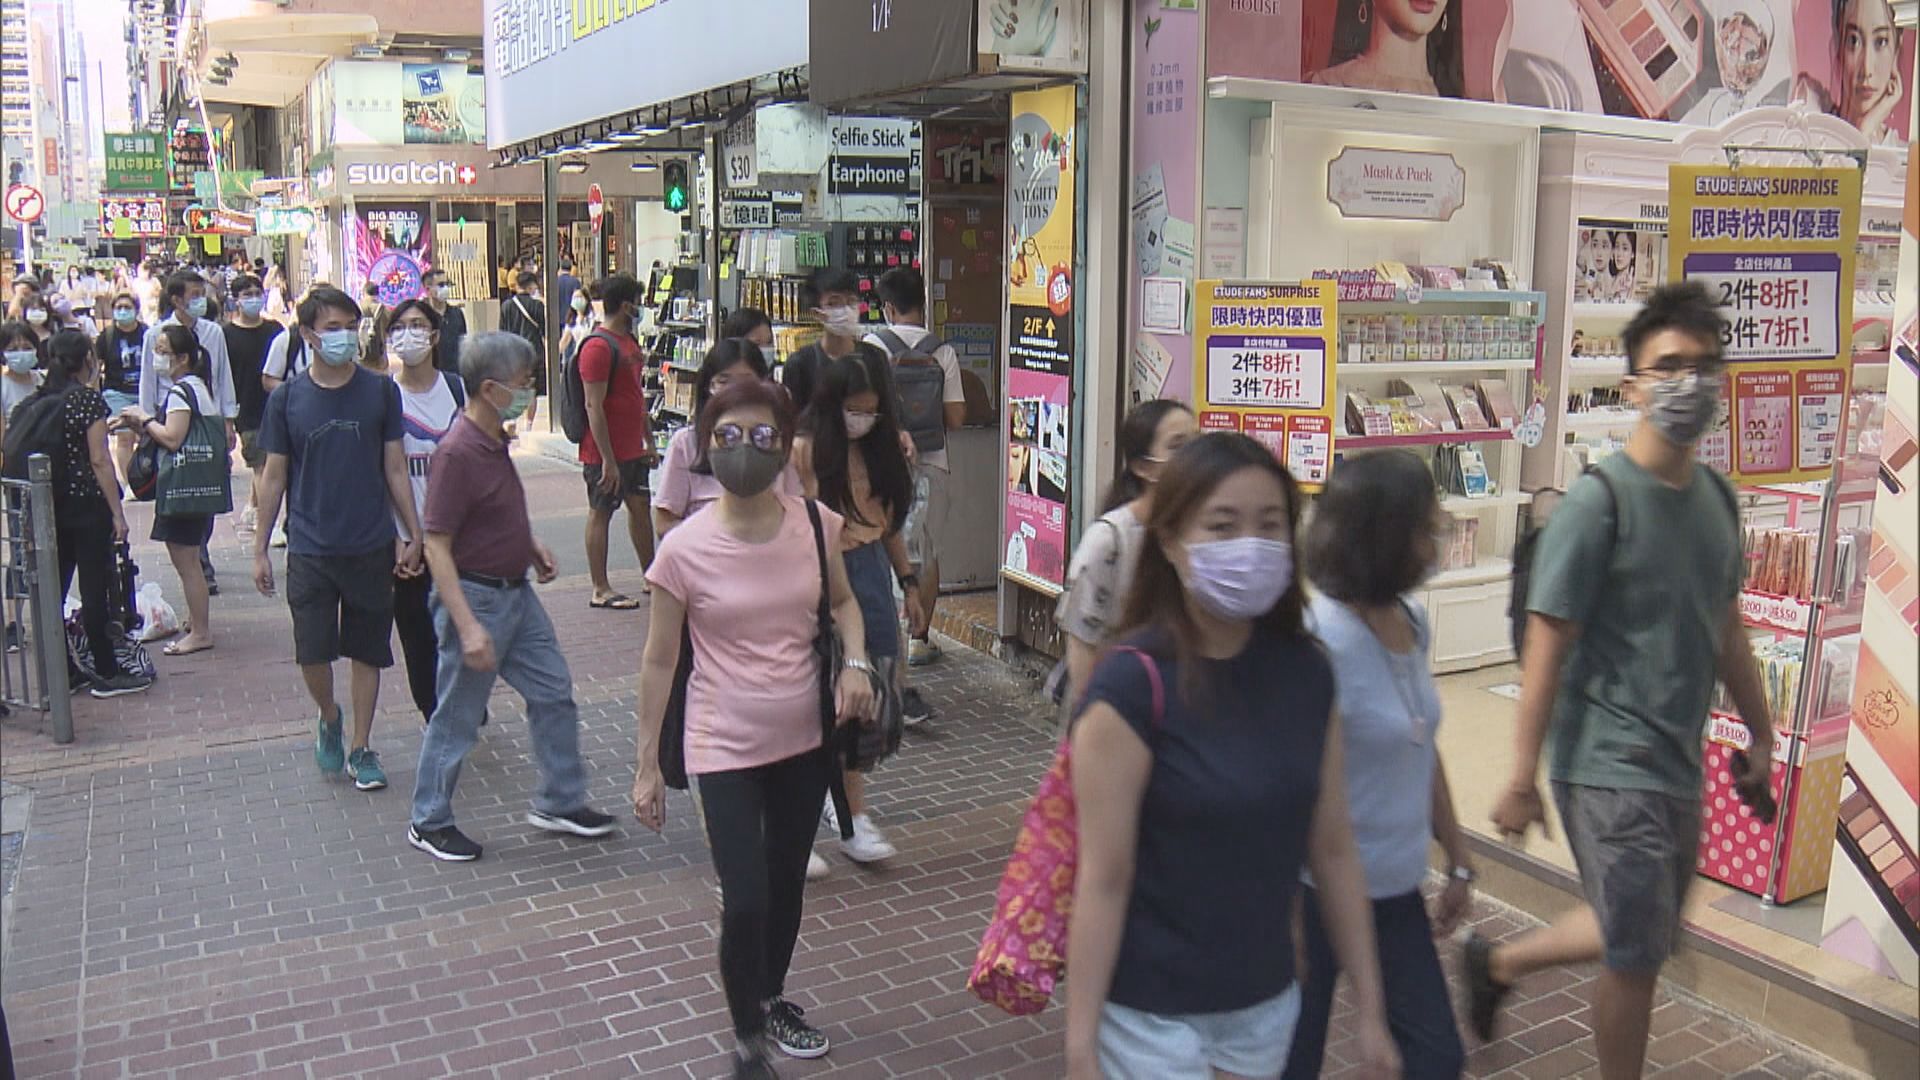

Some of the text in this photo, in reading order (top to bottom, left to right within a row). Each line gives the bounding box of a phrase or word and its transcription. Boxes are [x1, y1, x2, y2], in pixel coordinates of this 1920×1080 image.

[1151, 63, 1180, 76] 0.2mm
[832, 127, 905, 148] Selfie Stick
[348, 160, 457, 185] swatch
[731, 155, 750, 184] $30
[832, 162, 905, 188] Earphone
[1363, 164, 1433, 182] Mask & Pack
[1695, 176, 1838, 197] ETUDE FANS SURPRISE
[368, 211, 418, 221] BIG BOLD
[1024, 204, 1049, 219] TOYS
[1692, 207, 1841, 240] 限時快閃優惠
[1213, 287, 1320, 300] ETUDE FANS SURPRISE
[1719, 278, 1809, 310] 2件8折!
[1024, 317, 1043, 336] 2/F
[1211, 306, 1323, 328] 限時快閃優惠
[1720, 315, 1810, 348] 3件7折!
[1232, 351, 1300, 374] 2件8折!
[1232, 377, 1300, 399] 3件7折!
